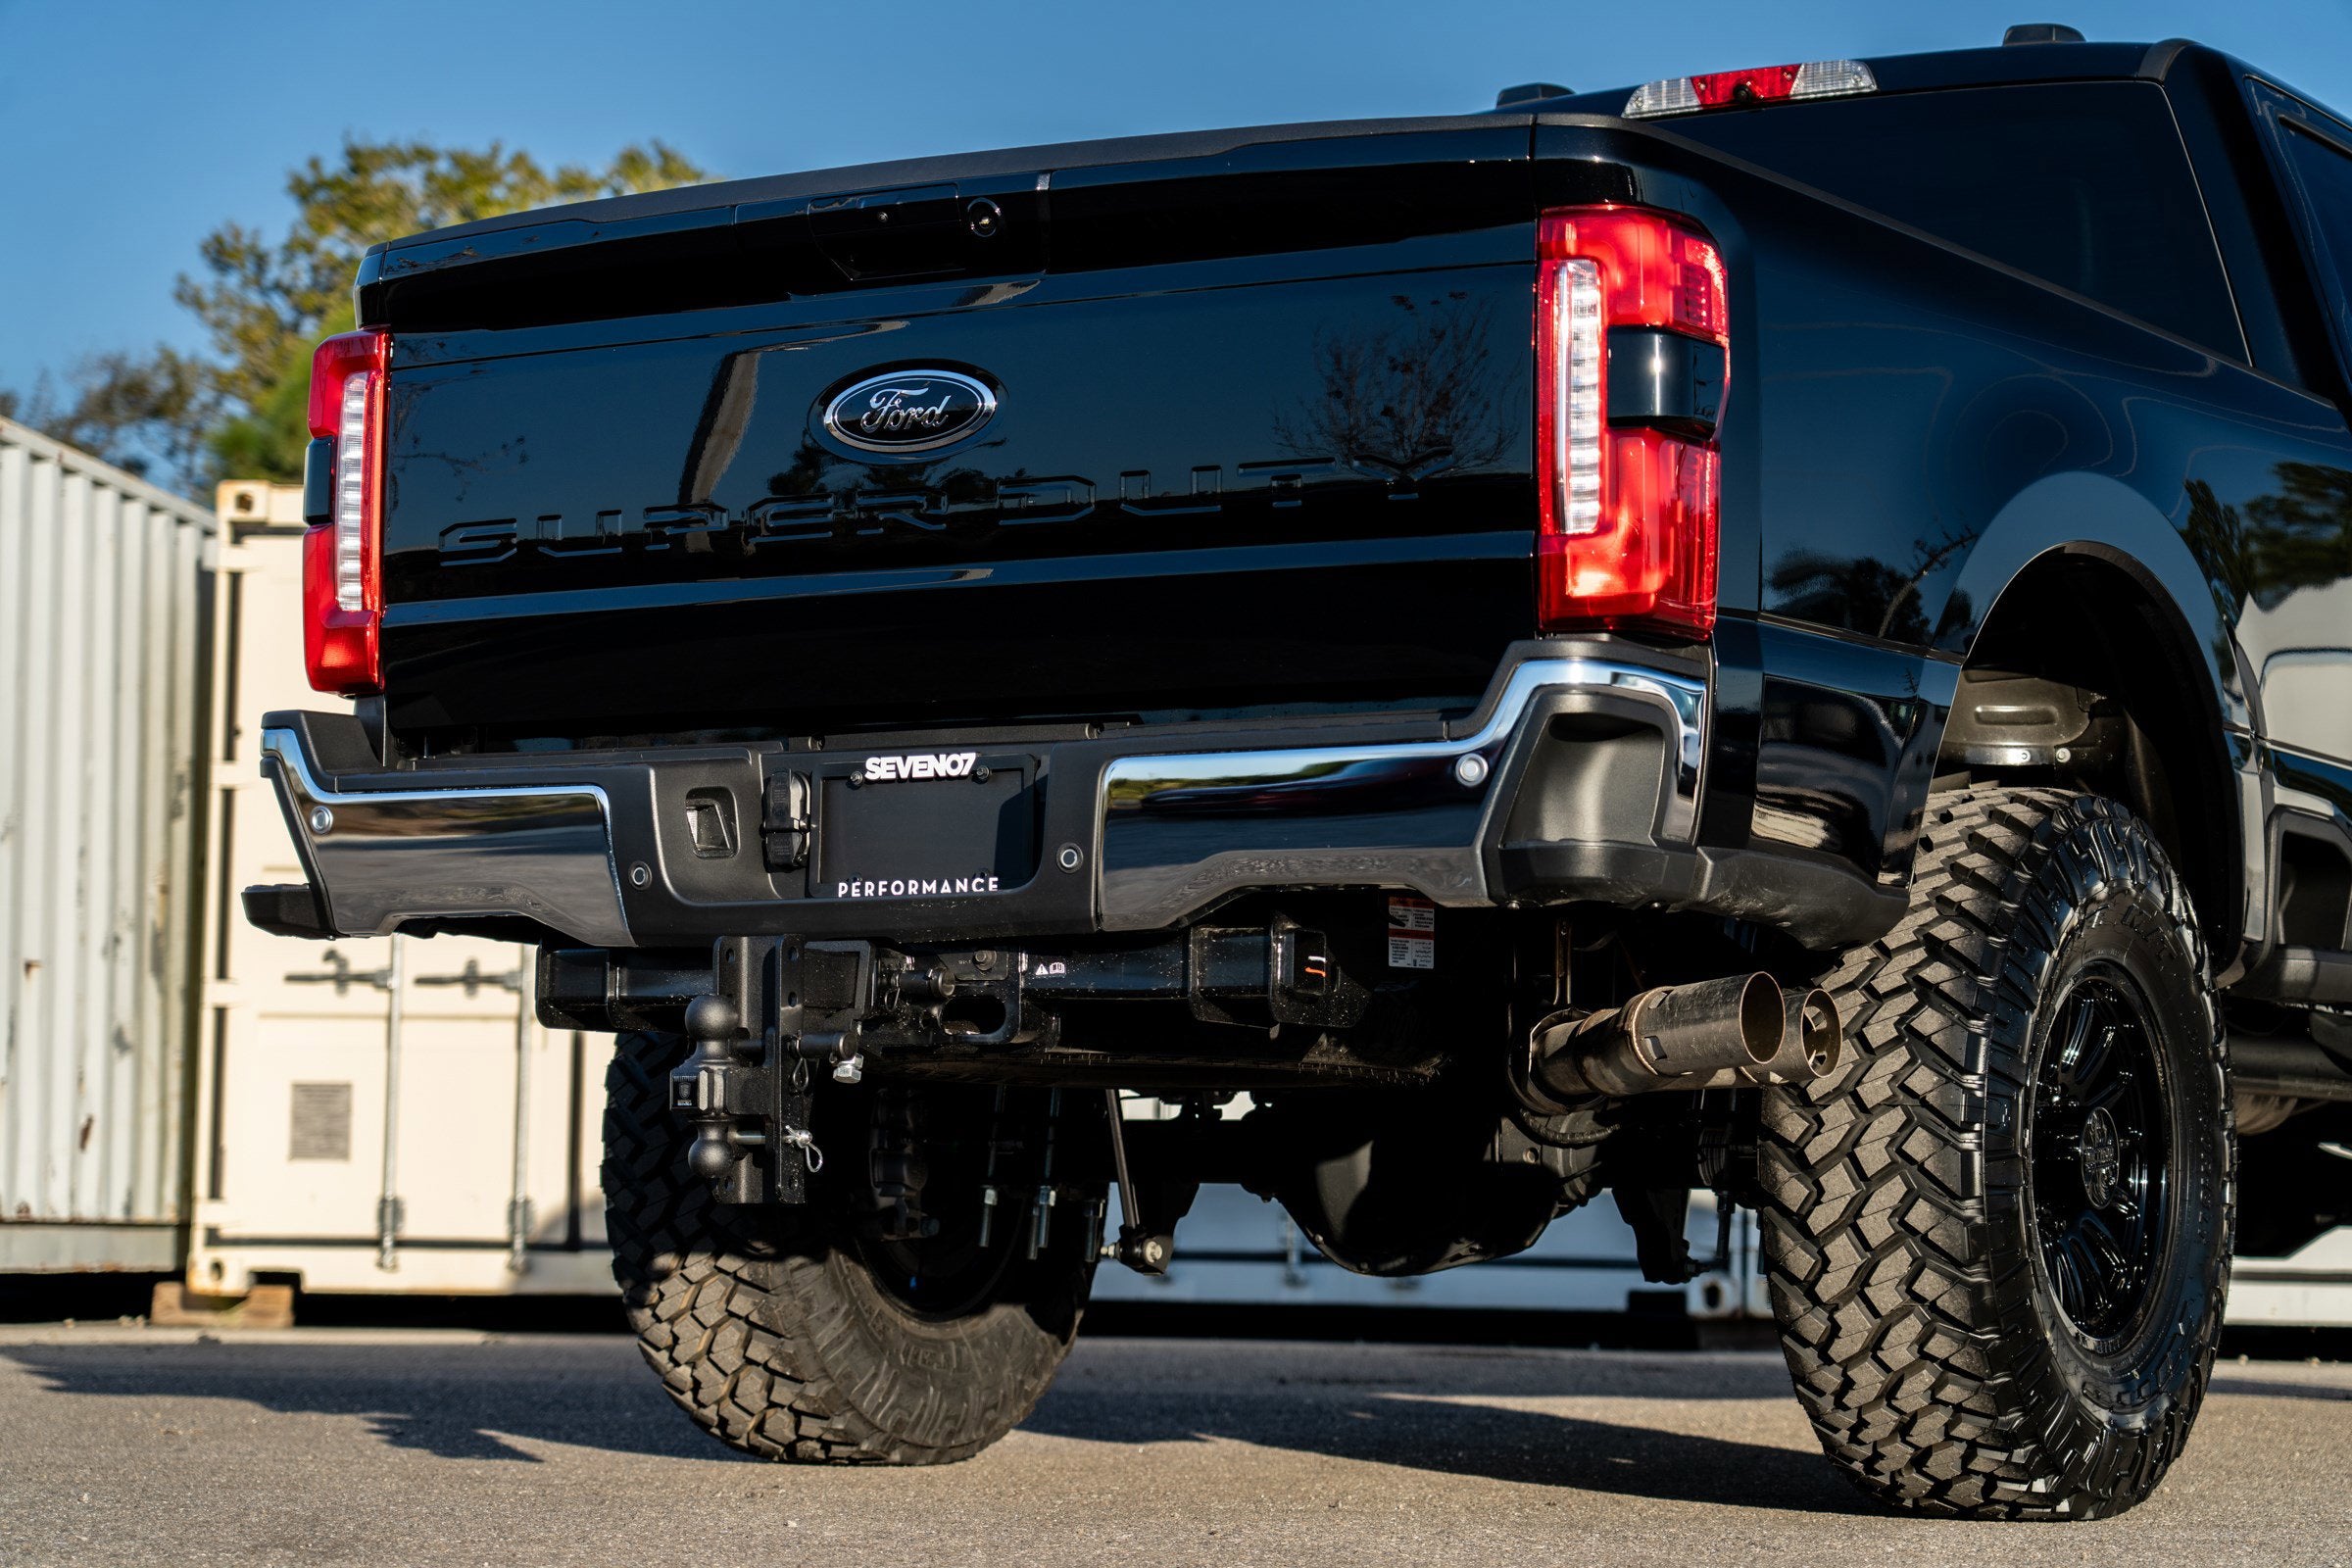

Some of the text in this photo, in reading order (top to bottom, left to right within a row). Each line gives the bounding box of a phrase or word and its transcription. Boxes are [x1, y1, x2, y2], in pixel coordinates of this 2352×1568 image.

[859, 386, 952, 434] Ford
[439, 447, 1455, 566] SUPER DUTY
[837, 876, 1000, 898] PERFORMANCE
